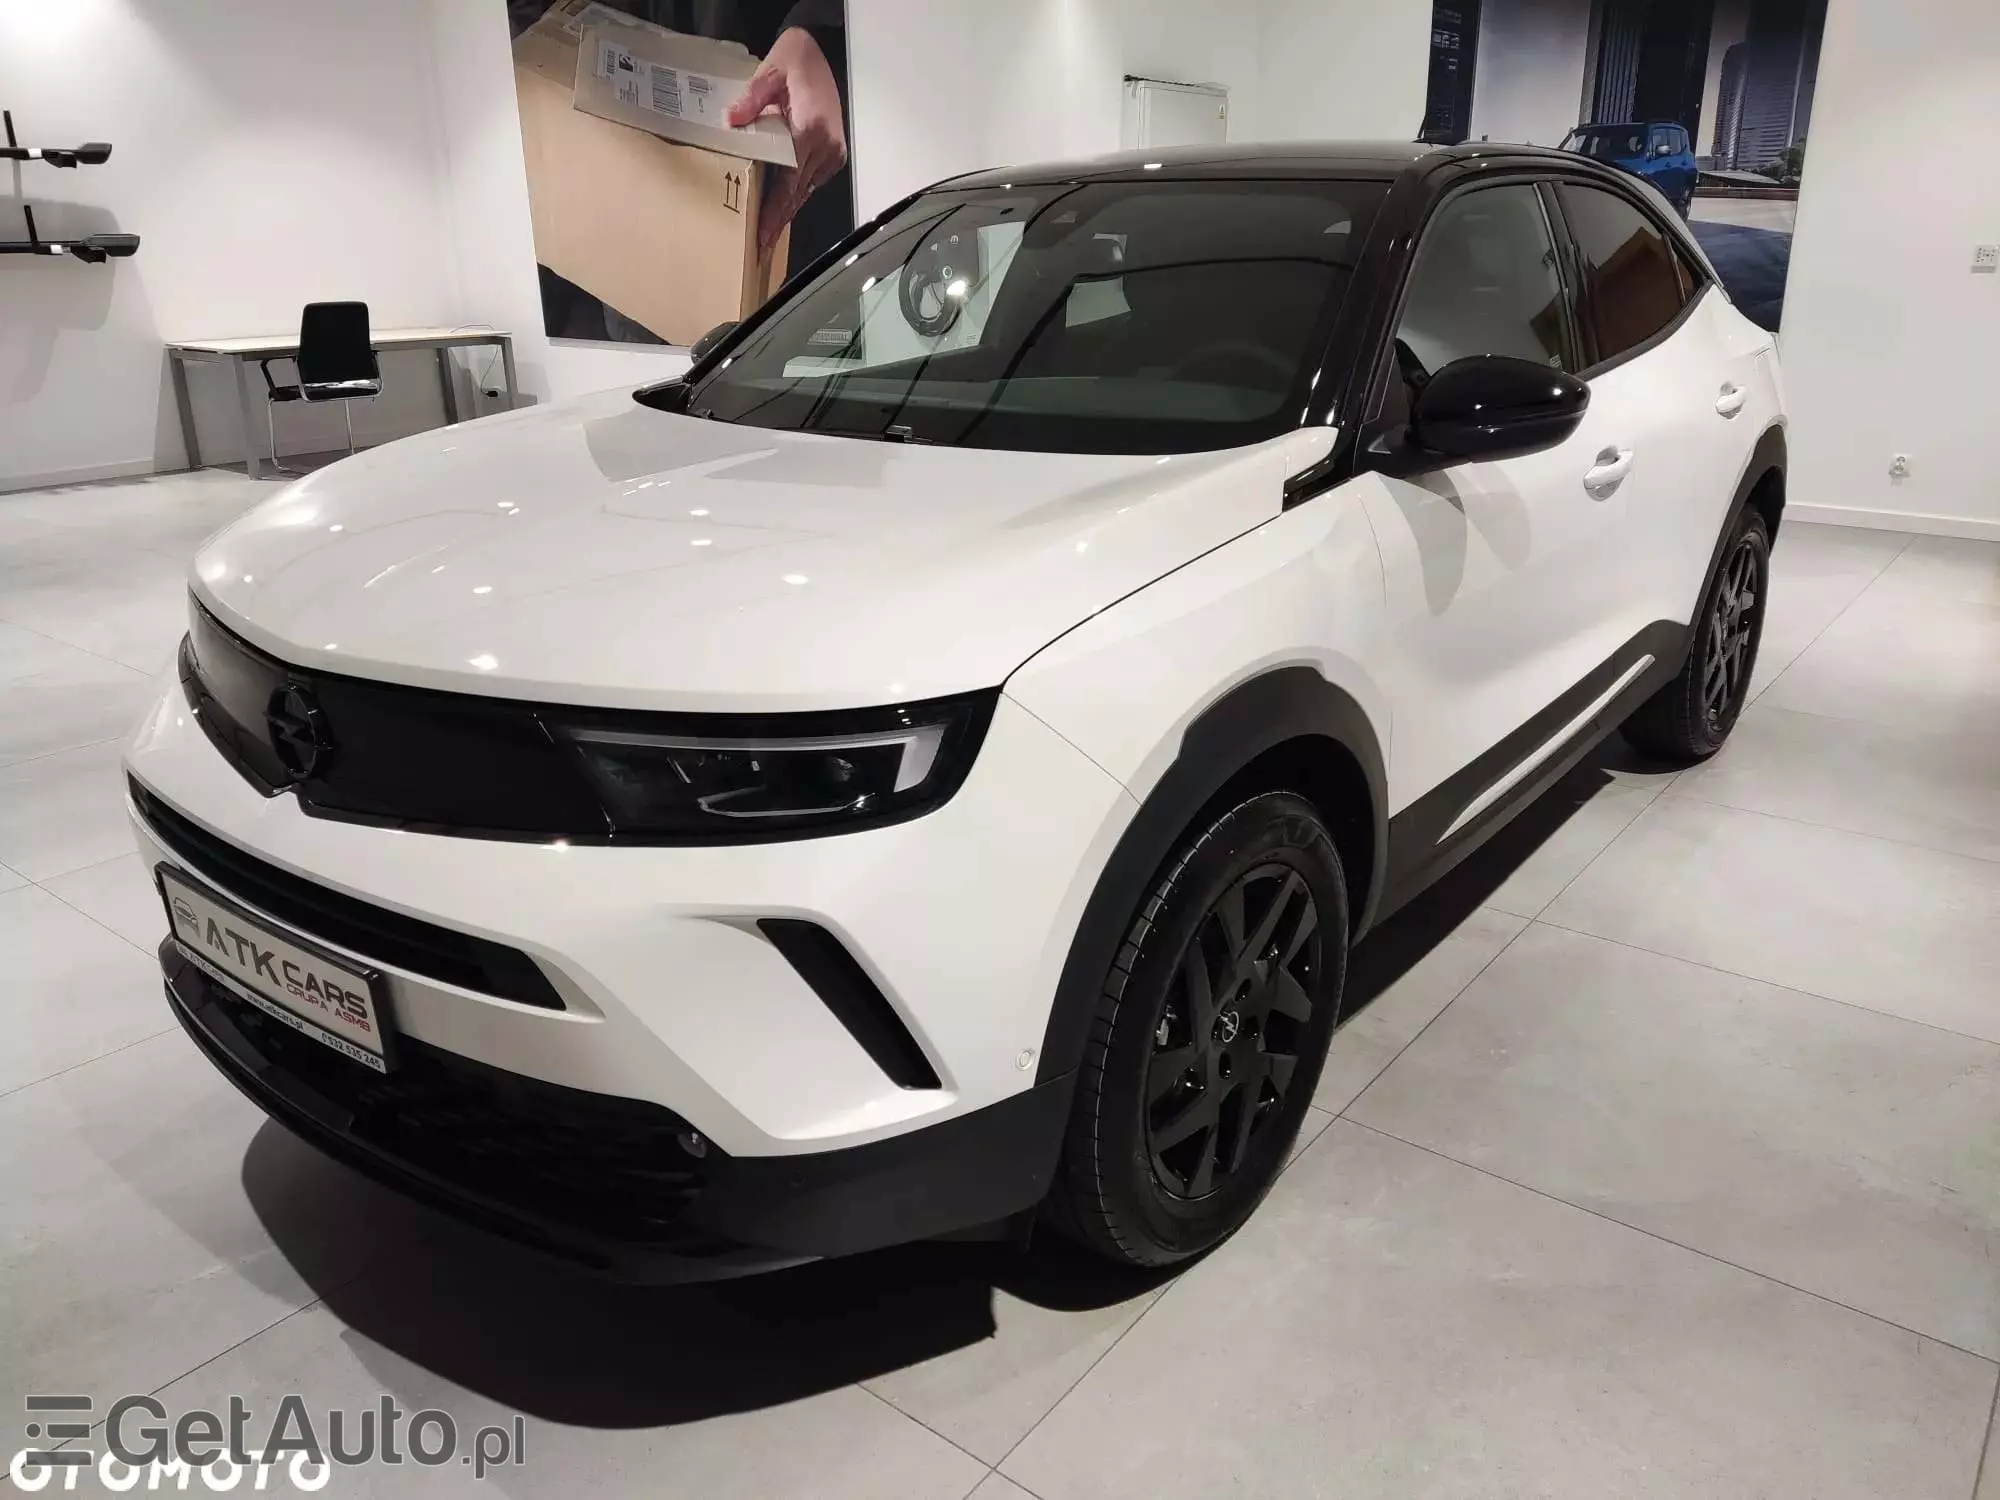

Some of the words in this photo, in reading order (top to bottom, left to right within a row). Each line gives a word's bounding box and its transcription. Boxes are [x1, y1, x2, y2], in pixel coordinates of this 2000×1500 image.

[206, 916, 281, 988] ATK
[281, 959, 368, 1020] CARS
[334, 1009, 371, 1032] ASMB
